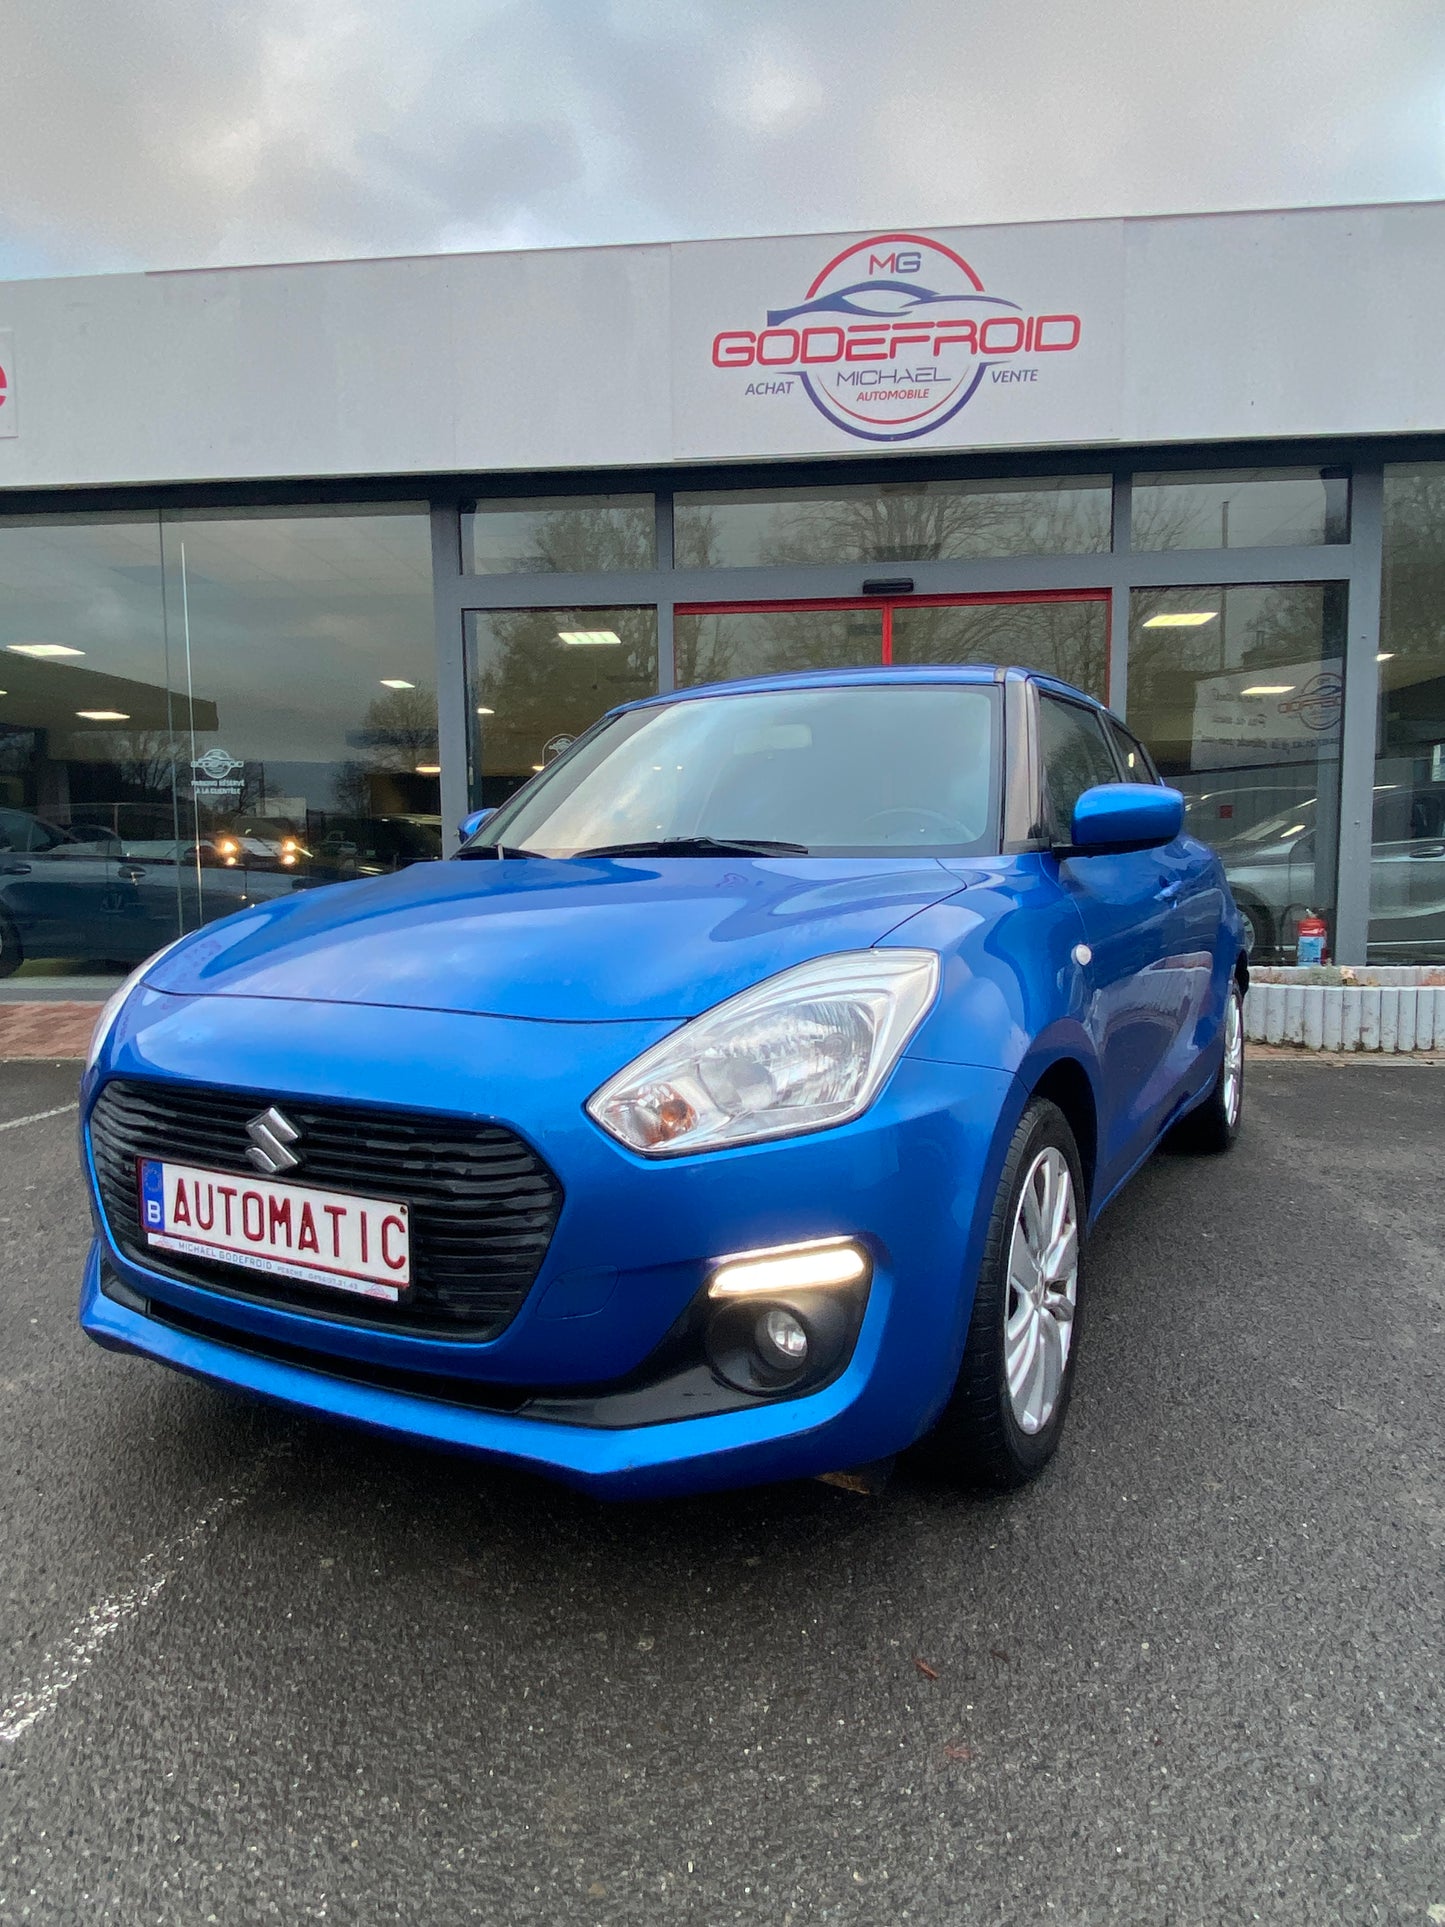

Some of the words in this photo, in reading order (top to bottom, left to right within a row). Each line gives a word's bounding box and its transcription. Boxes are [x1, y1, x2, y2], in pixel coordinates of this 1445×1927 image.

[869, 251, 922, 275] MG
[712, 314, 1081, 368] GODEFROID
[836, 366, 952, 387] MICHAEL
[991, 369, 1039, 384] VENTE
[745, 381, 794, 396] ACHAT
[856, 388, 930, 402] AUTOMOBILE
[147, 1200, 161, 1224] B
[173, 1177, 406, 1270] AUTOMATIC
[178, 1241, 217, 1258] MICHAEL
[219, 1251, 273, 1270] GODEFROID
